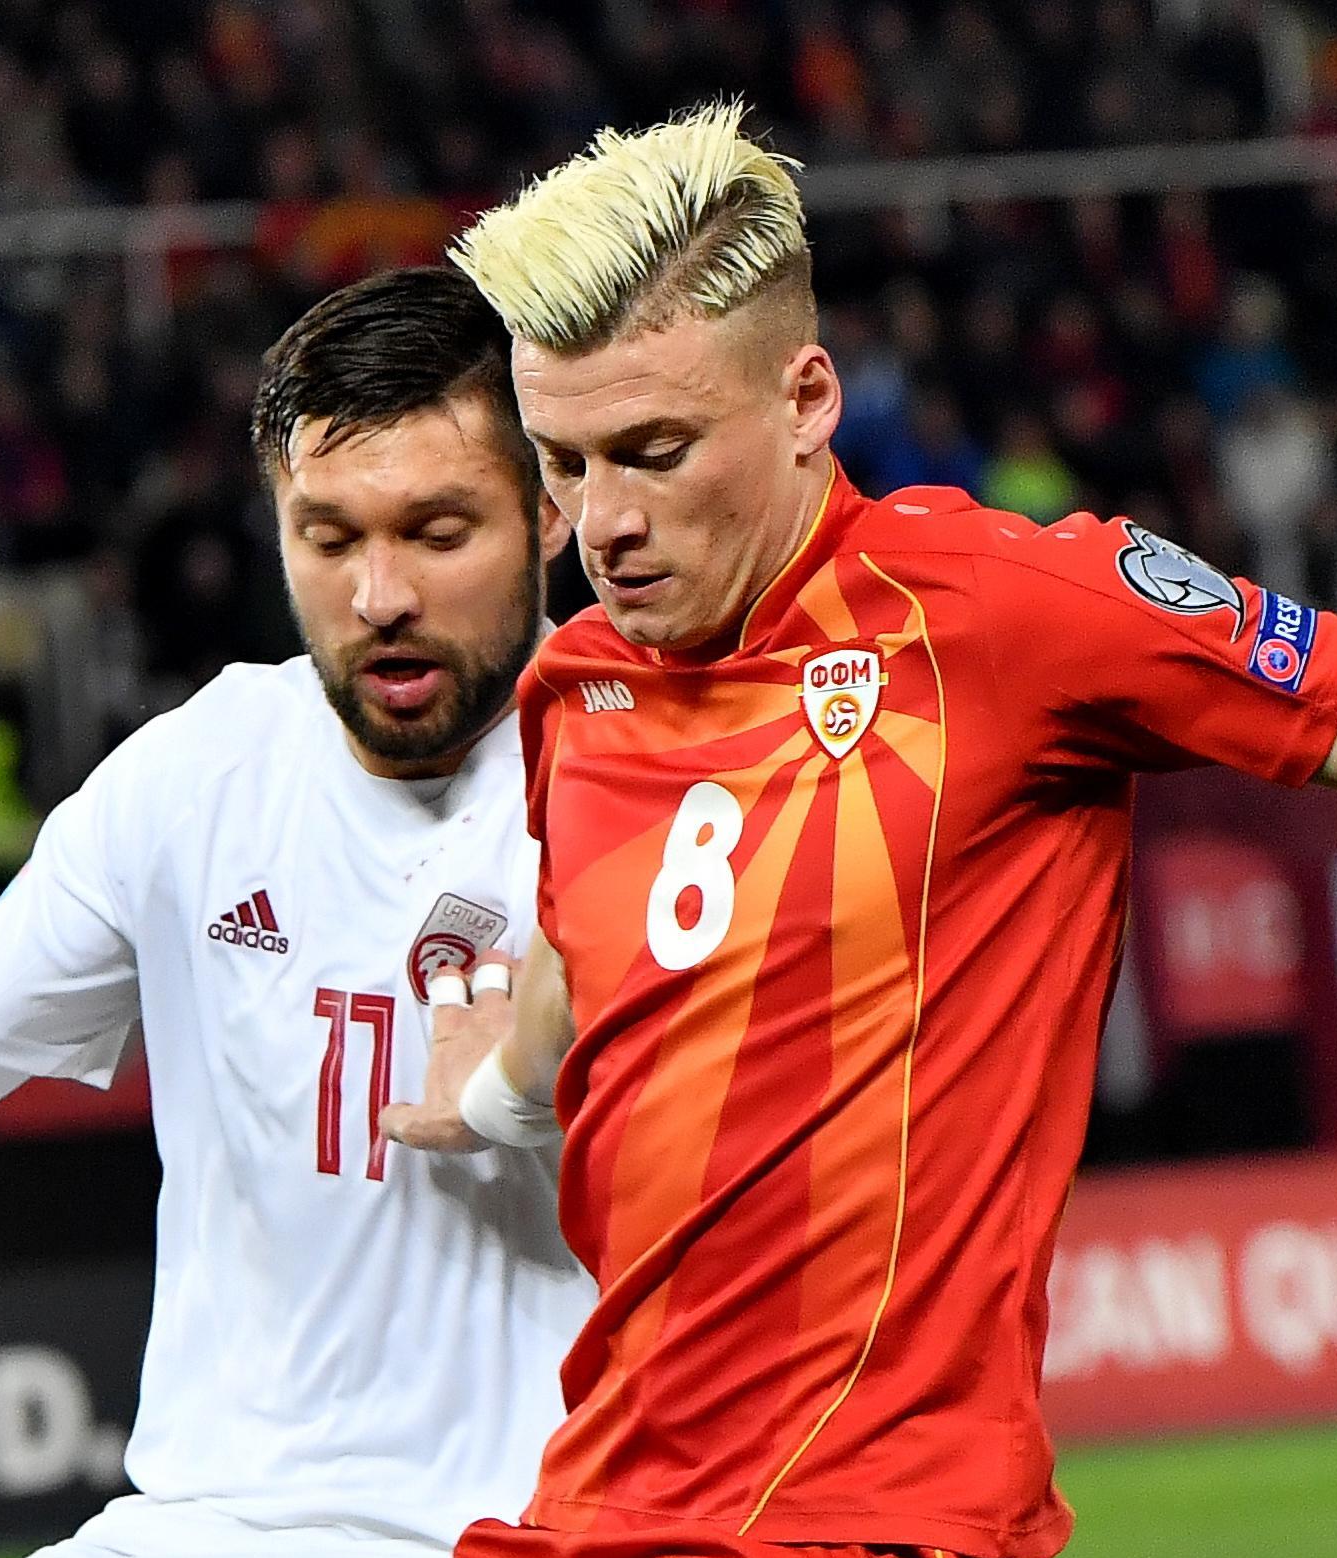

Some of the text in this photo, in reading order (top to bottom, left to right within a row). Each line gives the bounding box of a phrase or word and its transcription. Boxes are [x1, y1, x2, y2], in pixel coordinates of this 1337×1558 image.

[811, 658, 871, 689] ФФМ
[578, 679, 635, 713] JAKO
[646, 781, 744, 971] 8
[208, 922, 289, 954] adidas
[314, 987, 396, 1182] 11
